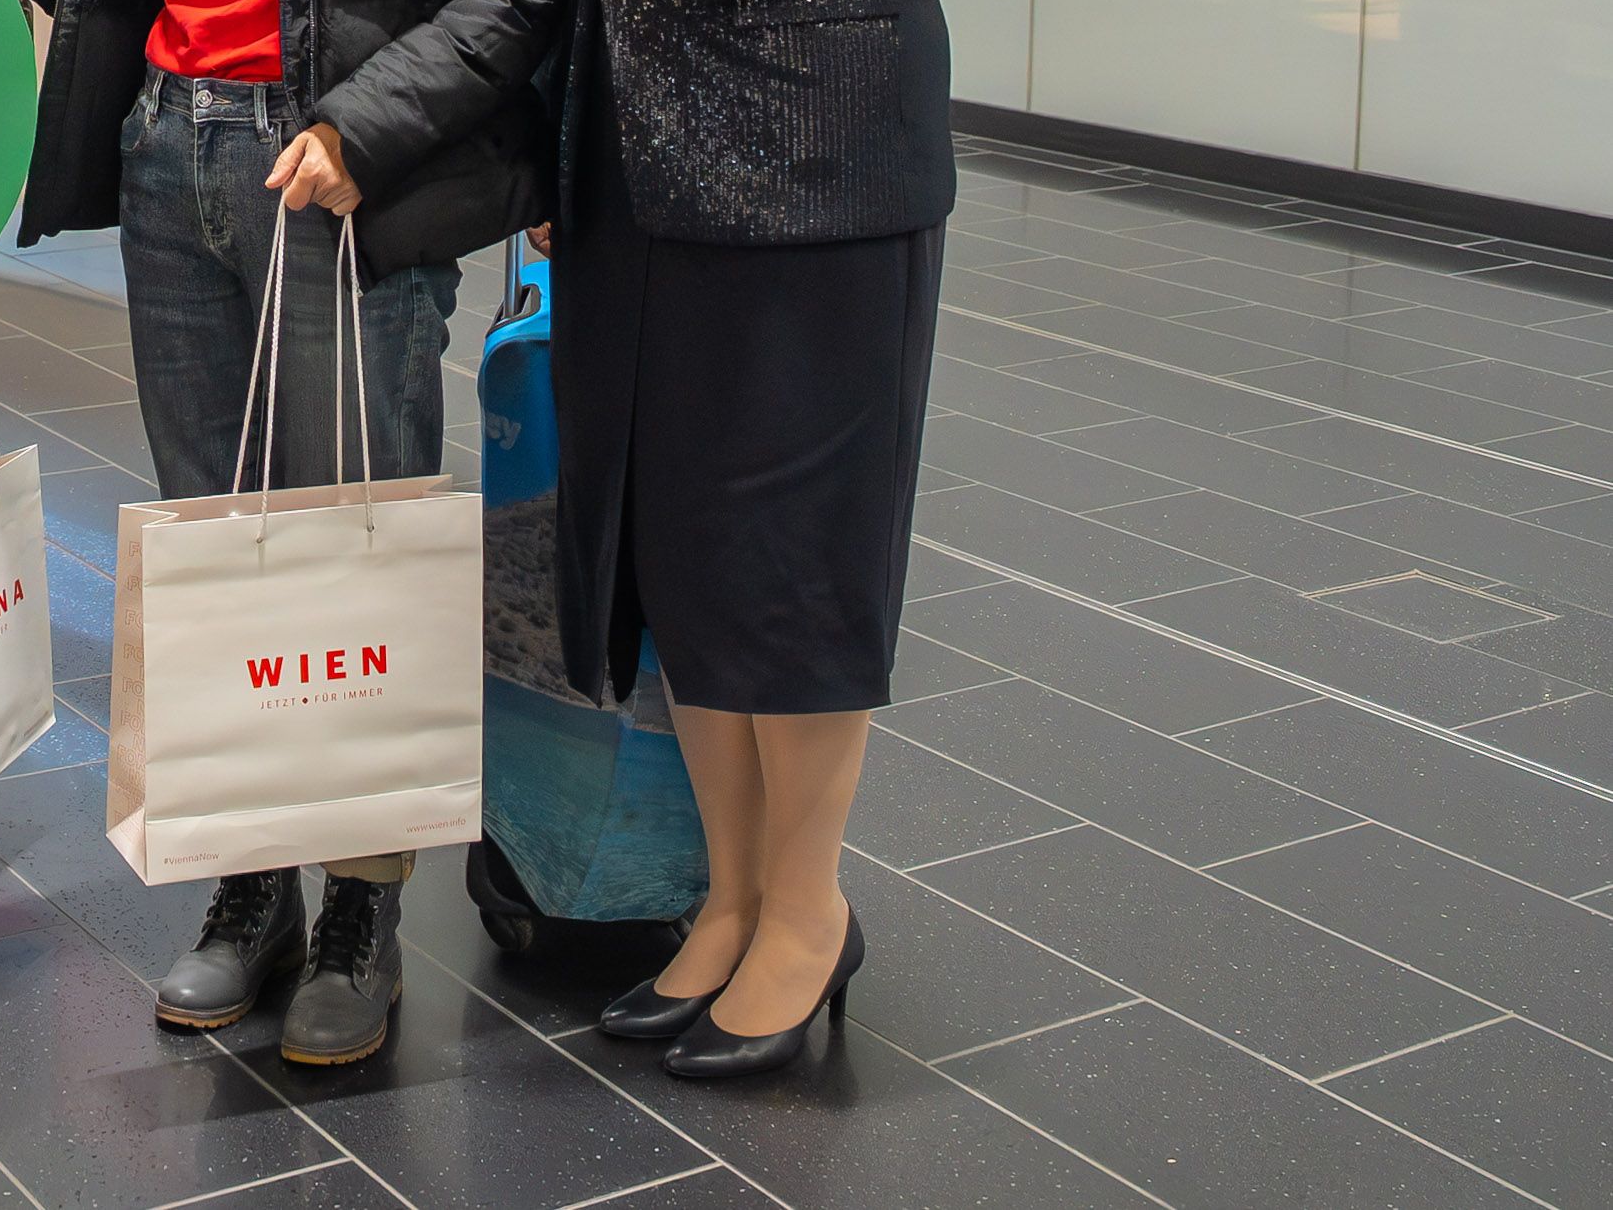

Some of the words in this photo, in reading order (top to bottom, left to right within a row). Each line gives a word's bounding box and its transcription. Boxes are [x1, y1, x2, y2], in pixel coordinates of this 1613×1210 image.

[247, 644, 387, 689] WIEN
[260, 697, 297, 710] JETZT
[314, 691, 339, 704] FÜR
[343, 687, 384, 701] IMMER
[406, 817, 467, 834] www.wien.info
[163, 851, 220, 865] #ViennaNow
